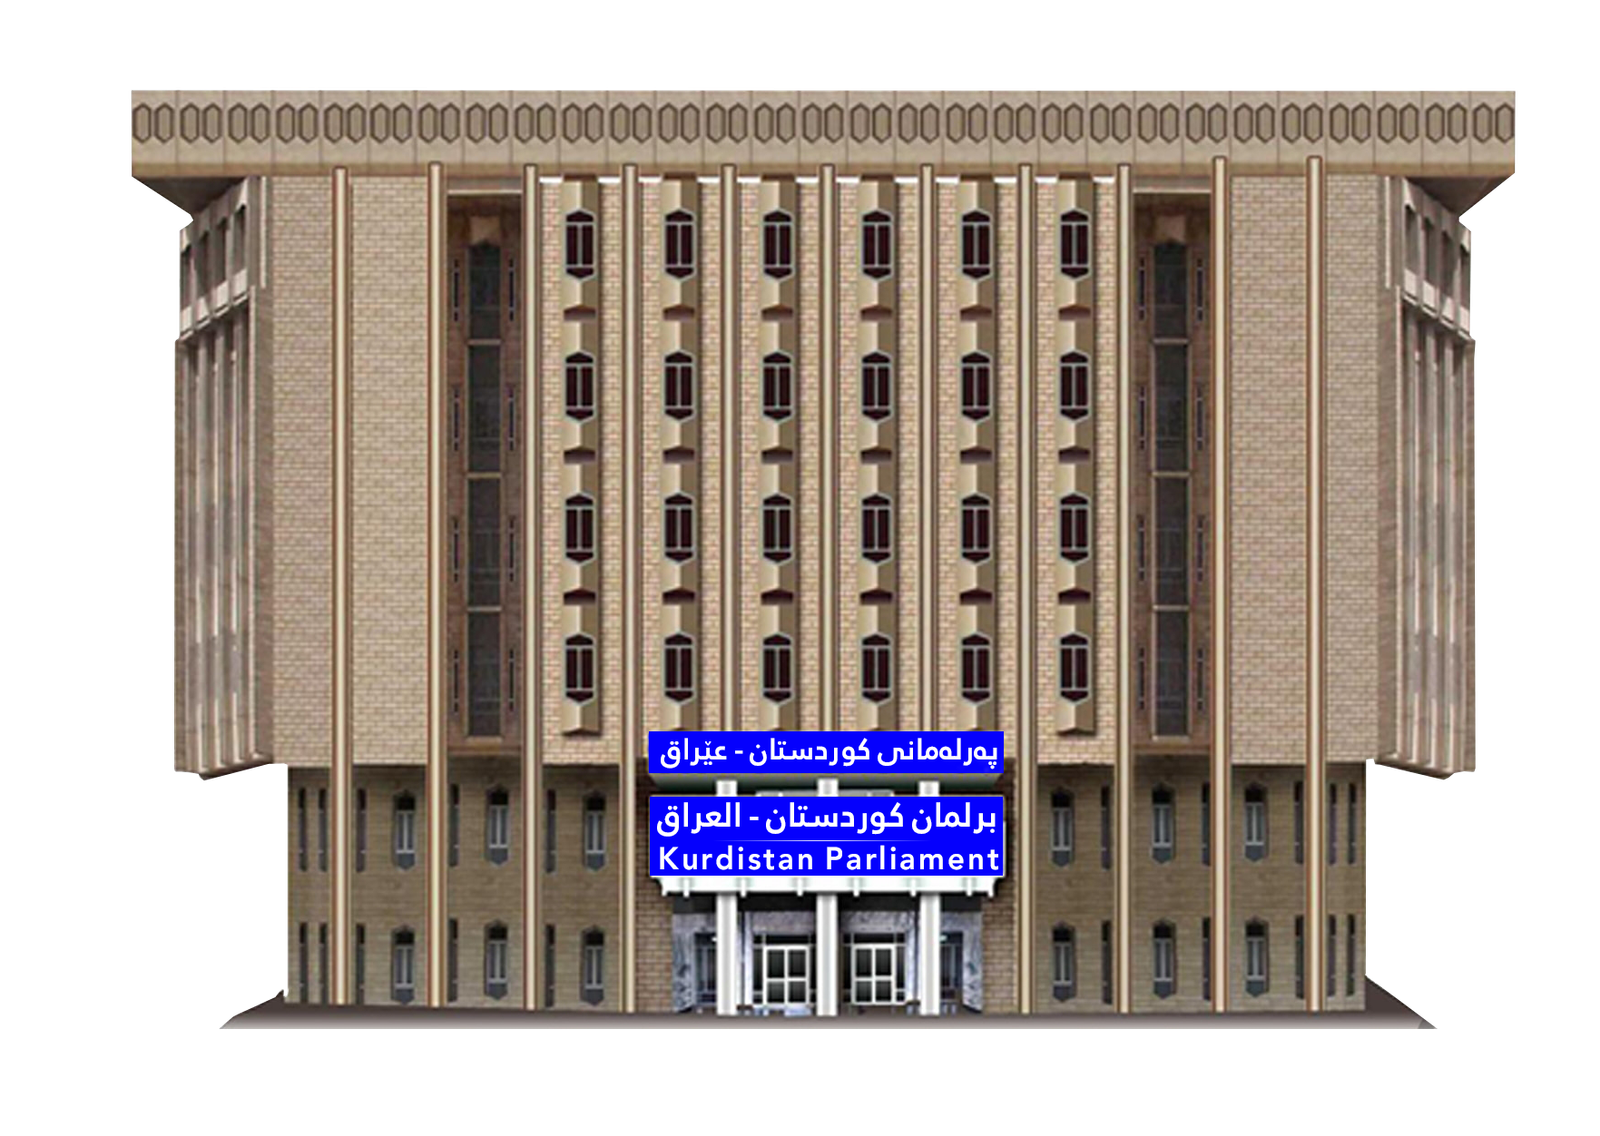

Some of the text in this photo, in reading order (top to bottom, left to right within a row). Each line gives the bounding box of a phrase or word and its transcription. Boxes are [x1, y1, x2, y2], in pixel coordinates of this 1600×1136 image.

[660, 738, 729, 768] عێراق
[657, 802, 741, 837] العراق
[912, 802, 996, 835] برلمان
[660, 845, 999, 870] Kurdistan Parliament
